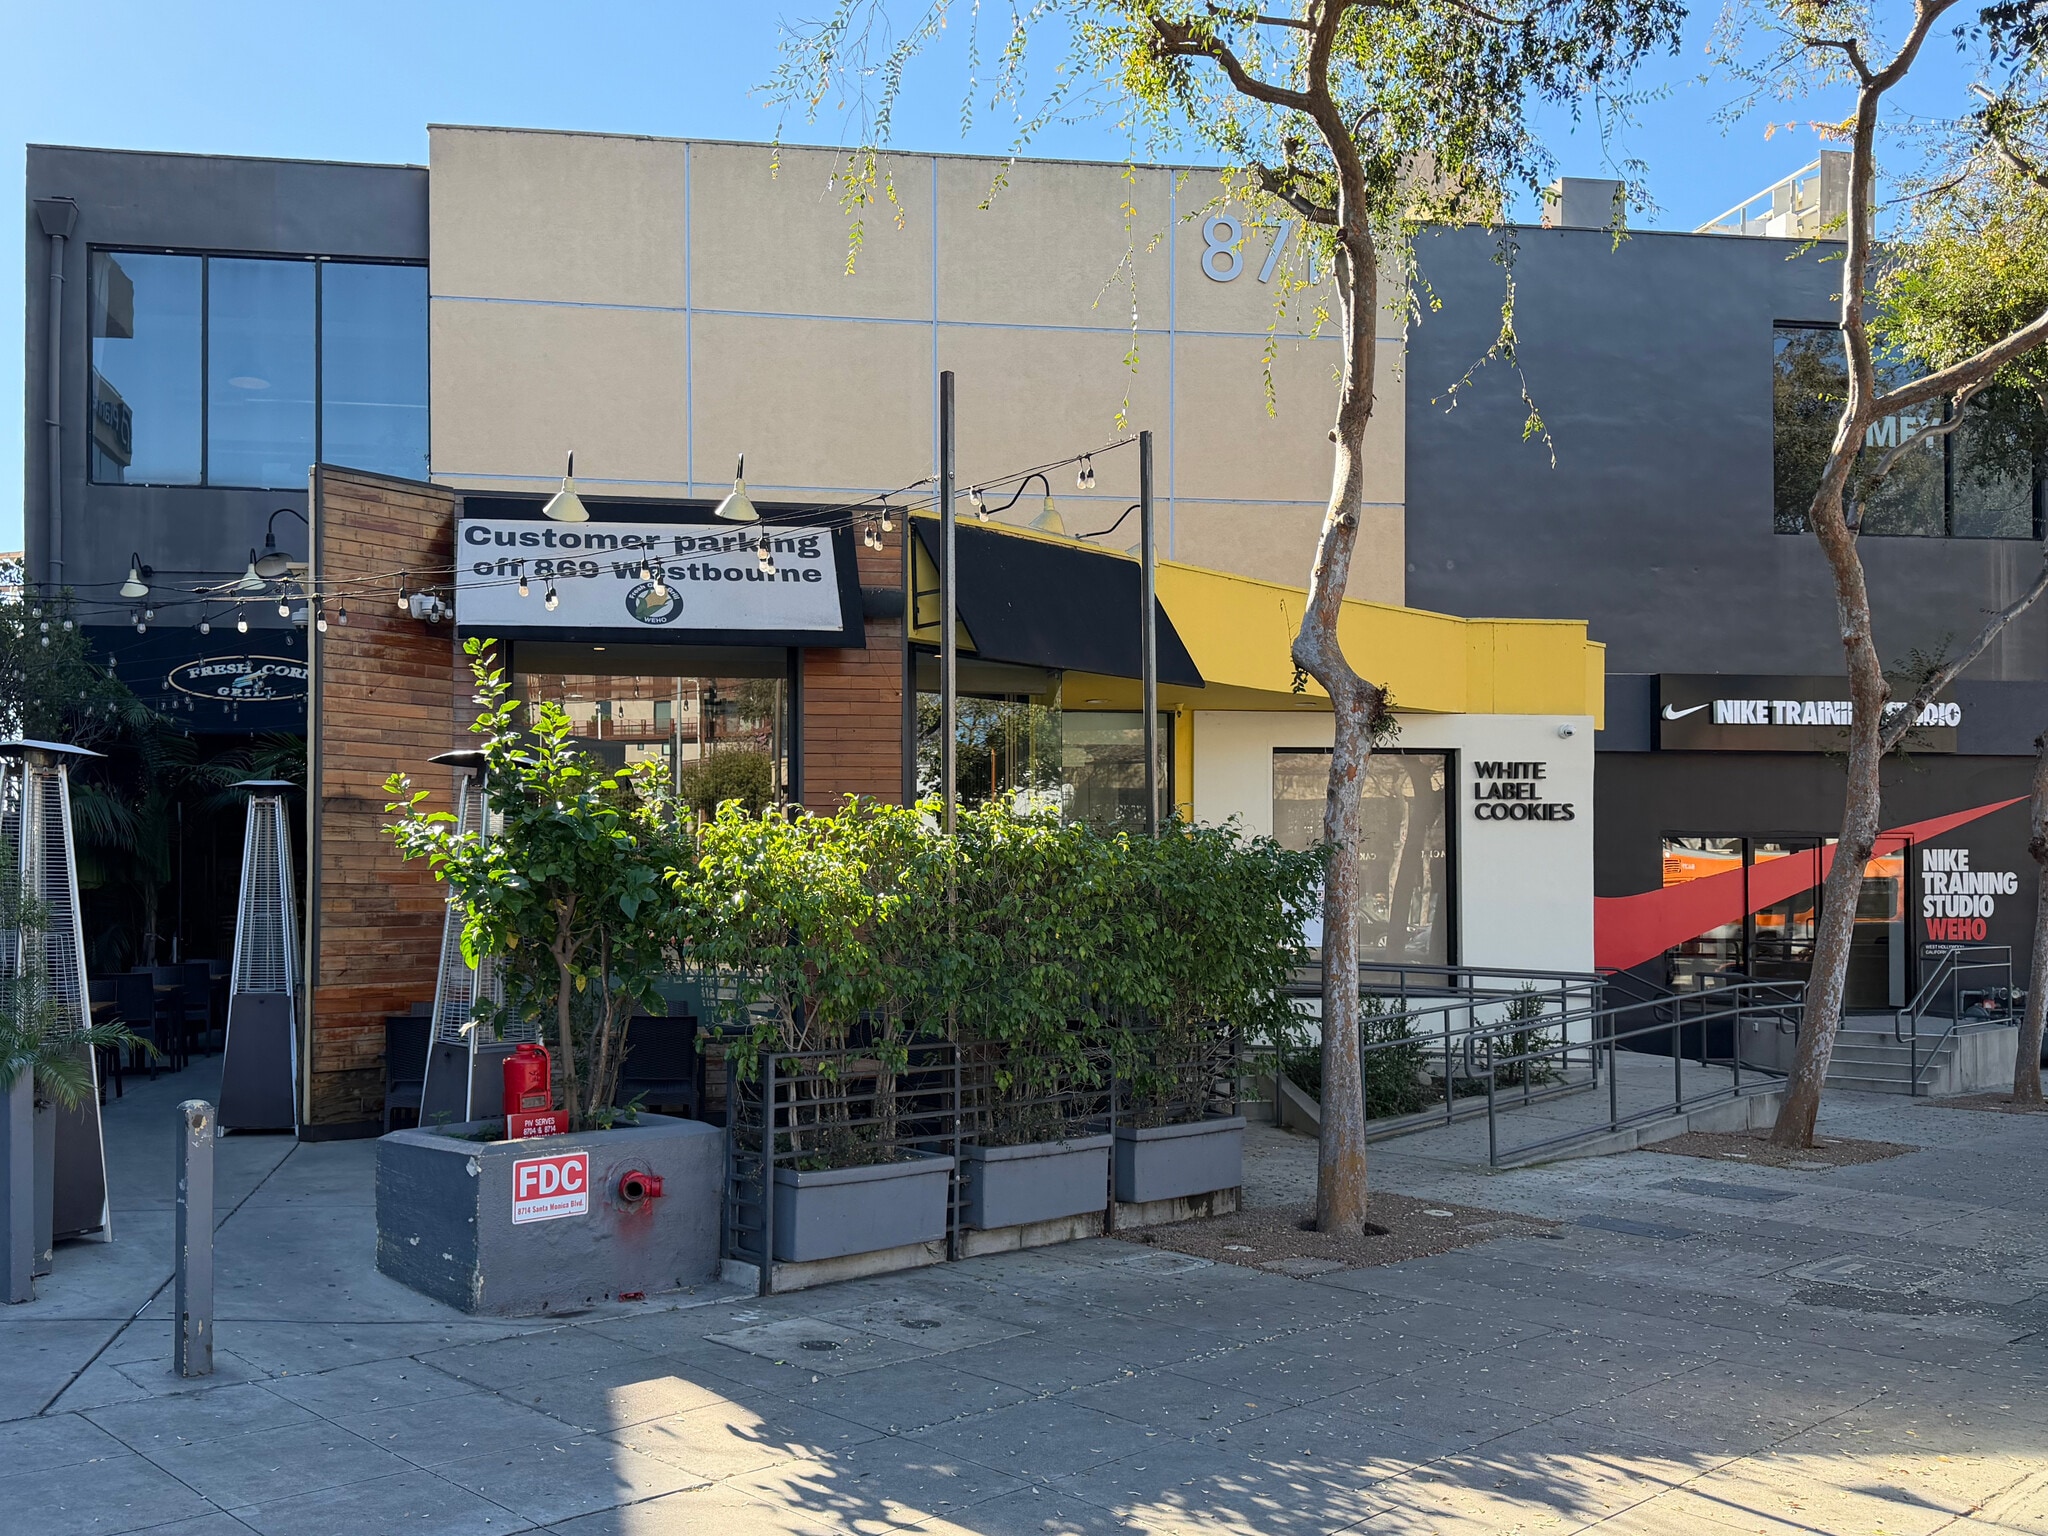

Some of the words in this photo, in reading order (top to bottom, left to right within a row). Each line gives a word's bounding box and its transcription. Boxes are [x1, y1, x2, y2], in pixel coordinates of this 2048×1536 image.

[464, 525, 661, 550] Customer
[674, 532, 821, 559] parking
[473, 558, 522, 576] off
[534, 559, 599, 579] 869
[629, 584, 646, 599] Fresh
[187, 663, 252, 679] FRESH
[1714, 699, 1769, 725] NIKE
[1770, 700, 1853, 725] TRAINI
[1474, 761, 1547, 779] WHITE
[1474, 782, 1543, 800] LABEL
[1474, 802, 1576, 821] COOKIES
[1922, 849, 1970, 872] NIKE
[1921, 871, 2019, 895] TRAINING
[1923, 894, 1995, 918] STUDIO
[1925, 917, 1987, 941] WEHO
[524, 1119, 533, 1127] PIV
[535, 1117, 555, 1126] SERVES
[519, 1160, 583, 1198] FDC
[517, 1206, 531, 1215] 8714
[532, 1204, 548, 1213] Santa
[550, 1202, 569, 1210] Monica
[570, 1199, 584, 1207] Blvd.
